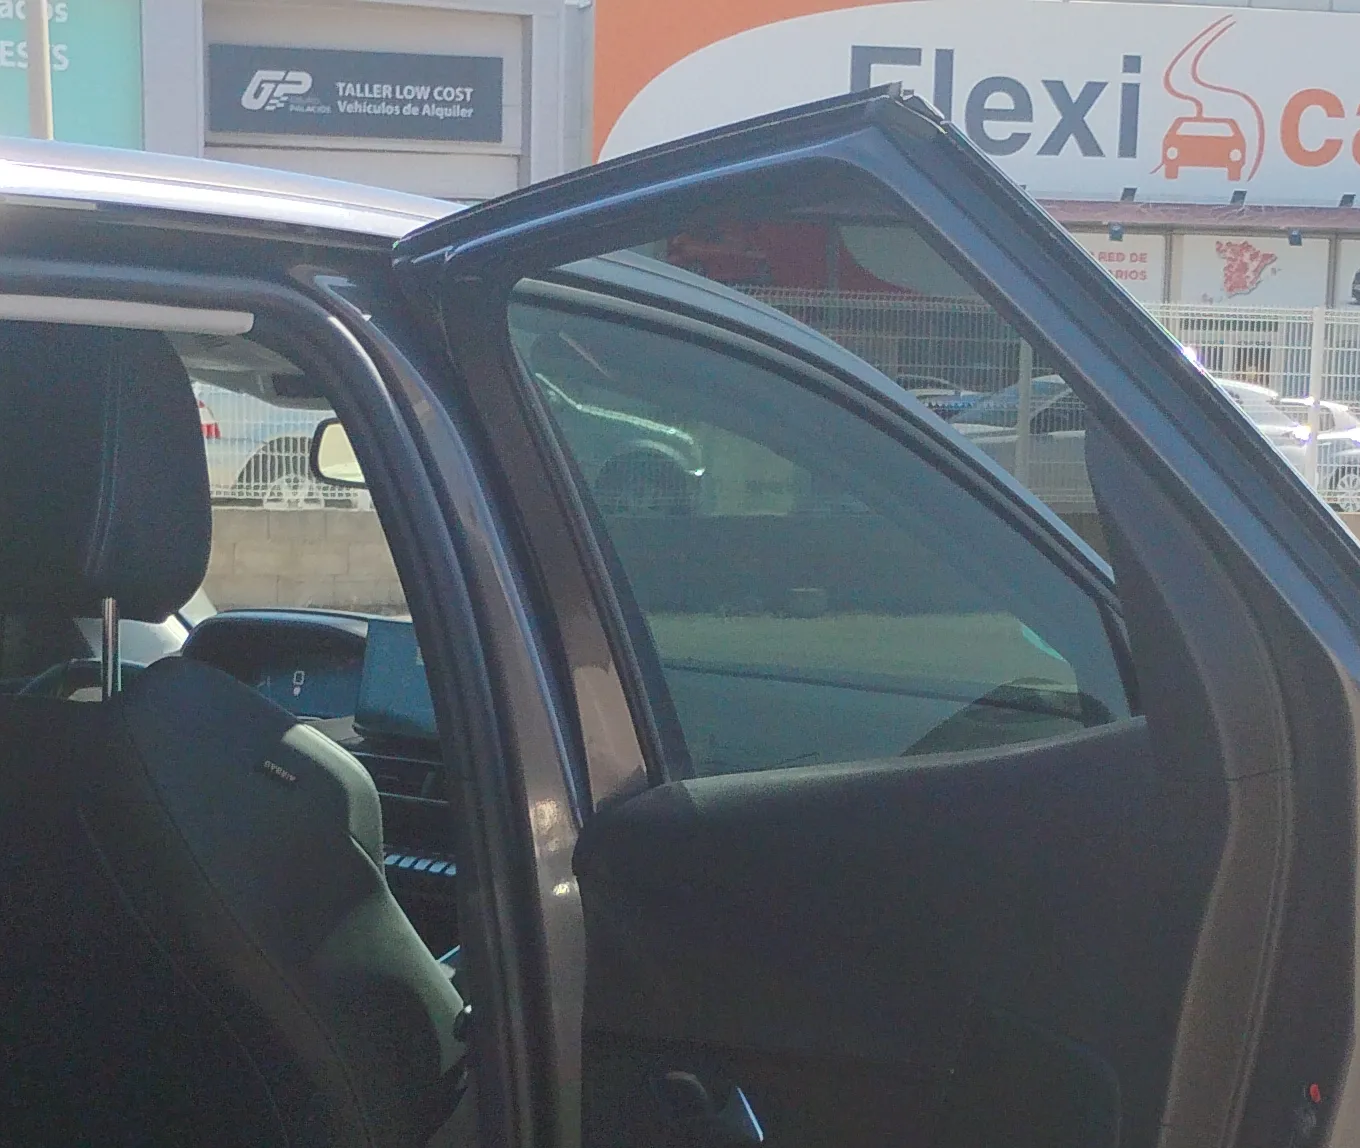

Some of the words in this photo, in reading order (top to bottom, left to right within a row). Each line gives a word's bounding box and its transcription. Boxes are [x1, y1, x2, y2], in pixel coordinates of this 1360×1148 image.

[336, 82, 392, 99] TALLER
[395, 85, 431, 100] LOW
[433, 86, 474, 102] COST
[402, 103, 420, 116] de
[422, 103, 474, 119] Alquiler
[1129, 252, 1148, 264] DE
